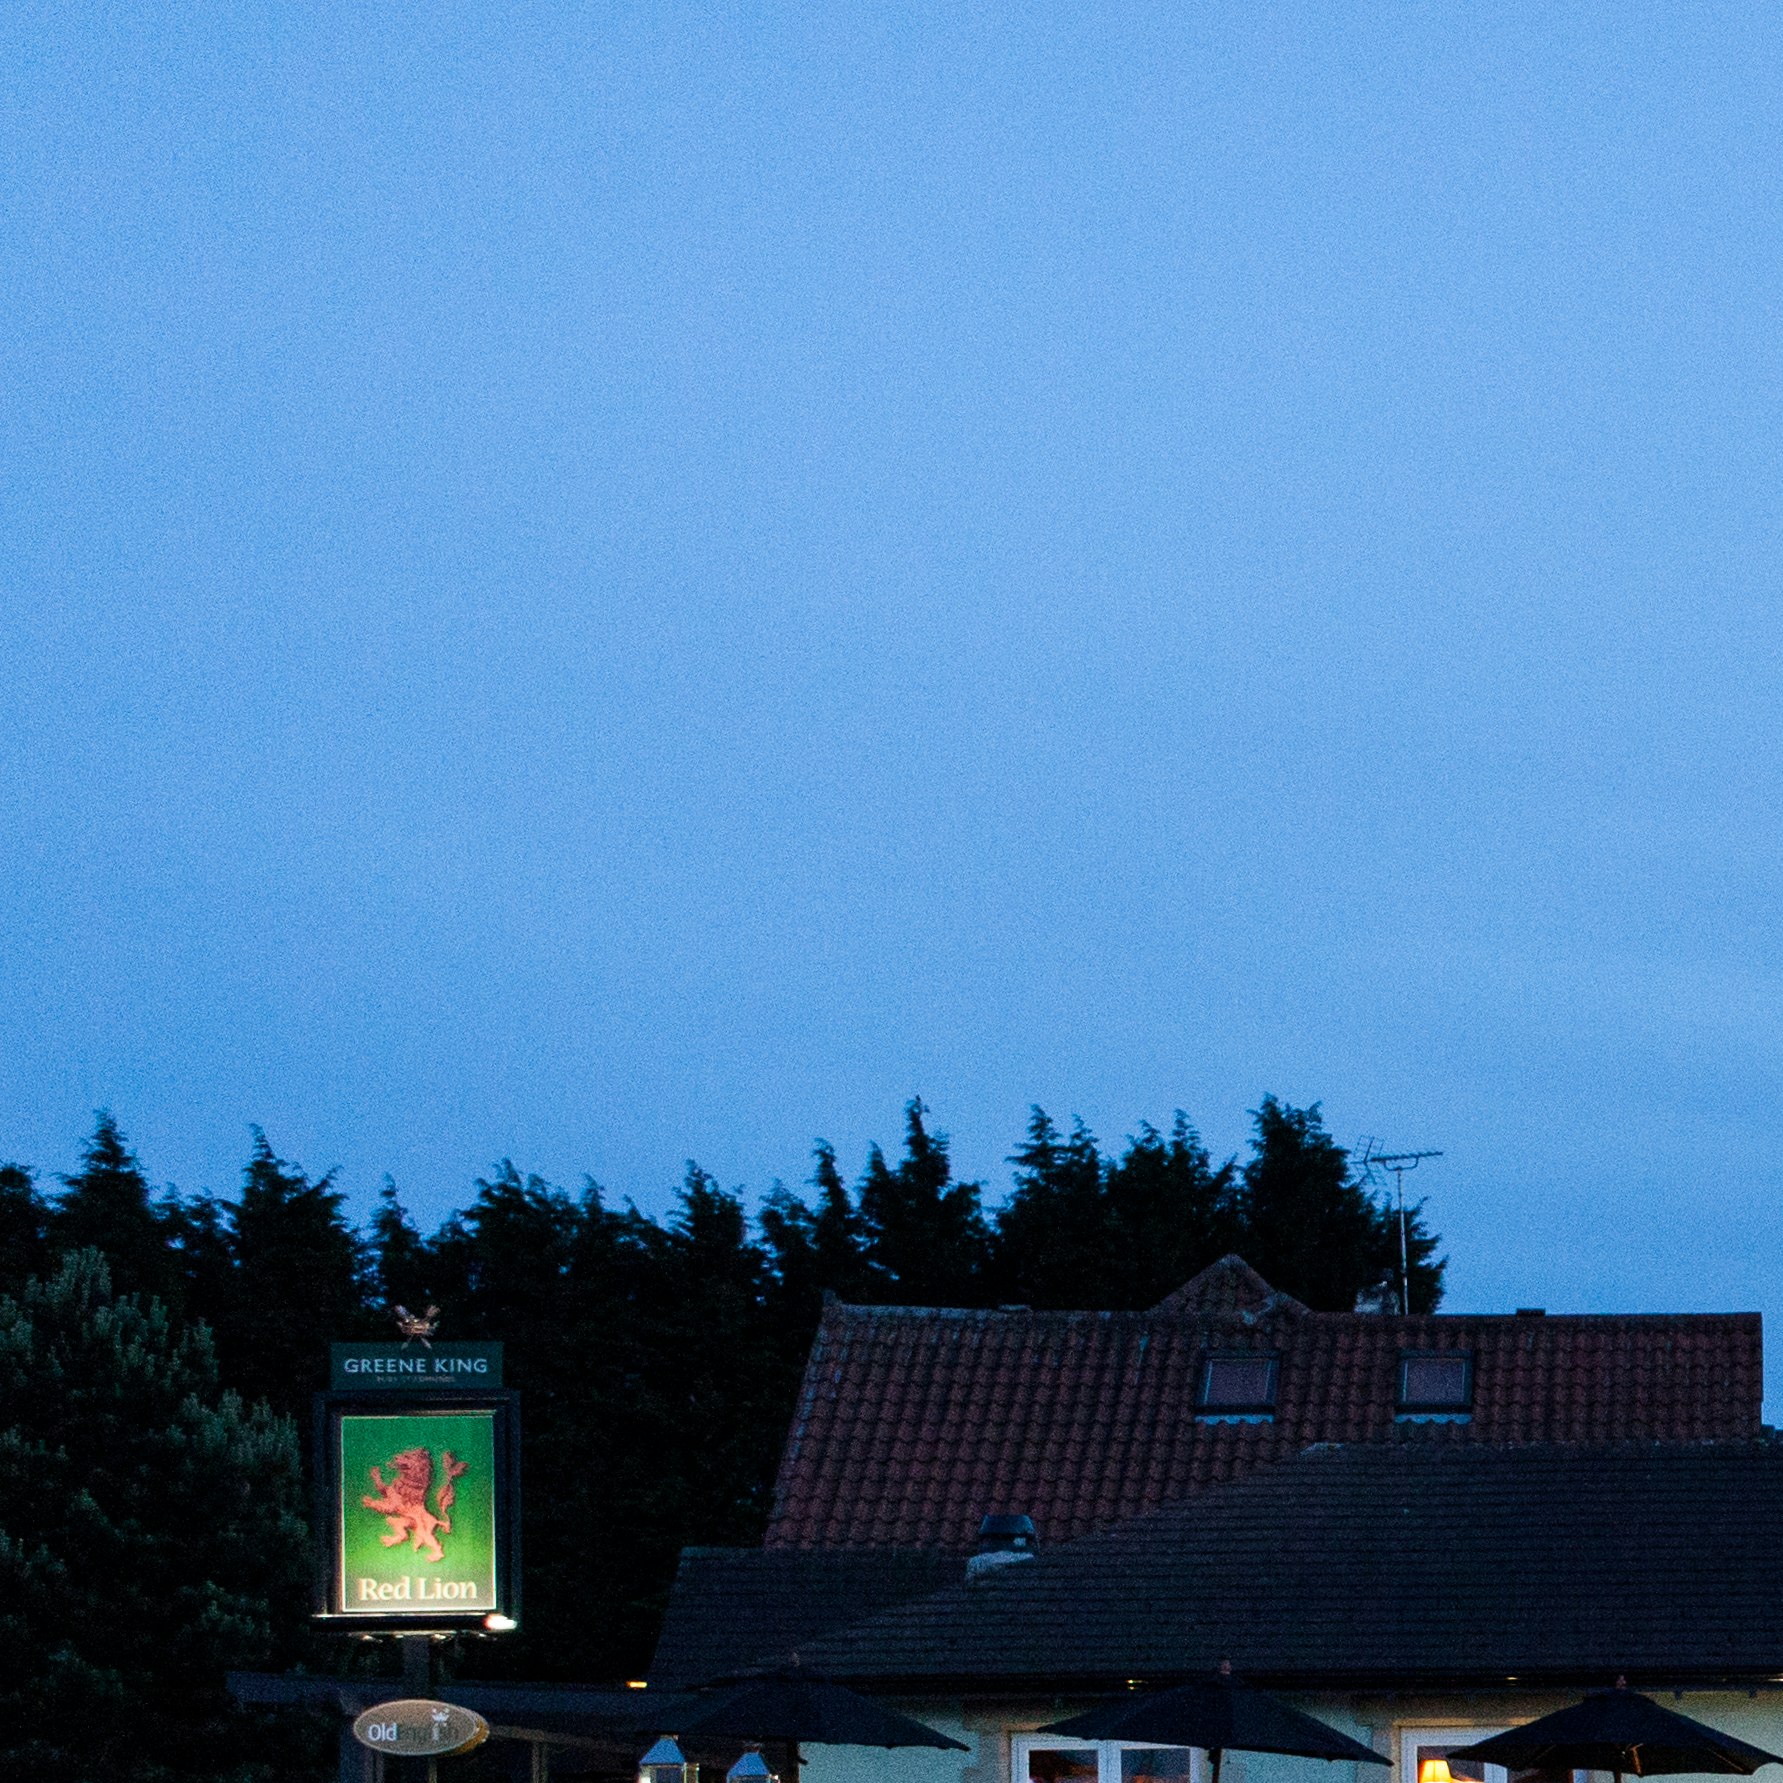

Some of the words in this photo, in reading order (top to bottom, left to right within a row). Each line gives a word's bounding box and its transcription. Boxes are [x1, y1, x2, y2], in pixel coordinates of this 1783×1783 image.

[344, 1358, 427, 1373] GREENE
[434, 1358, 488, 1374] KING
[358, 1576, 411, 1600] Red
[418, 1578, 477, 1600] Lion
[368, 1722, 398, 1742] Old
